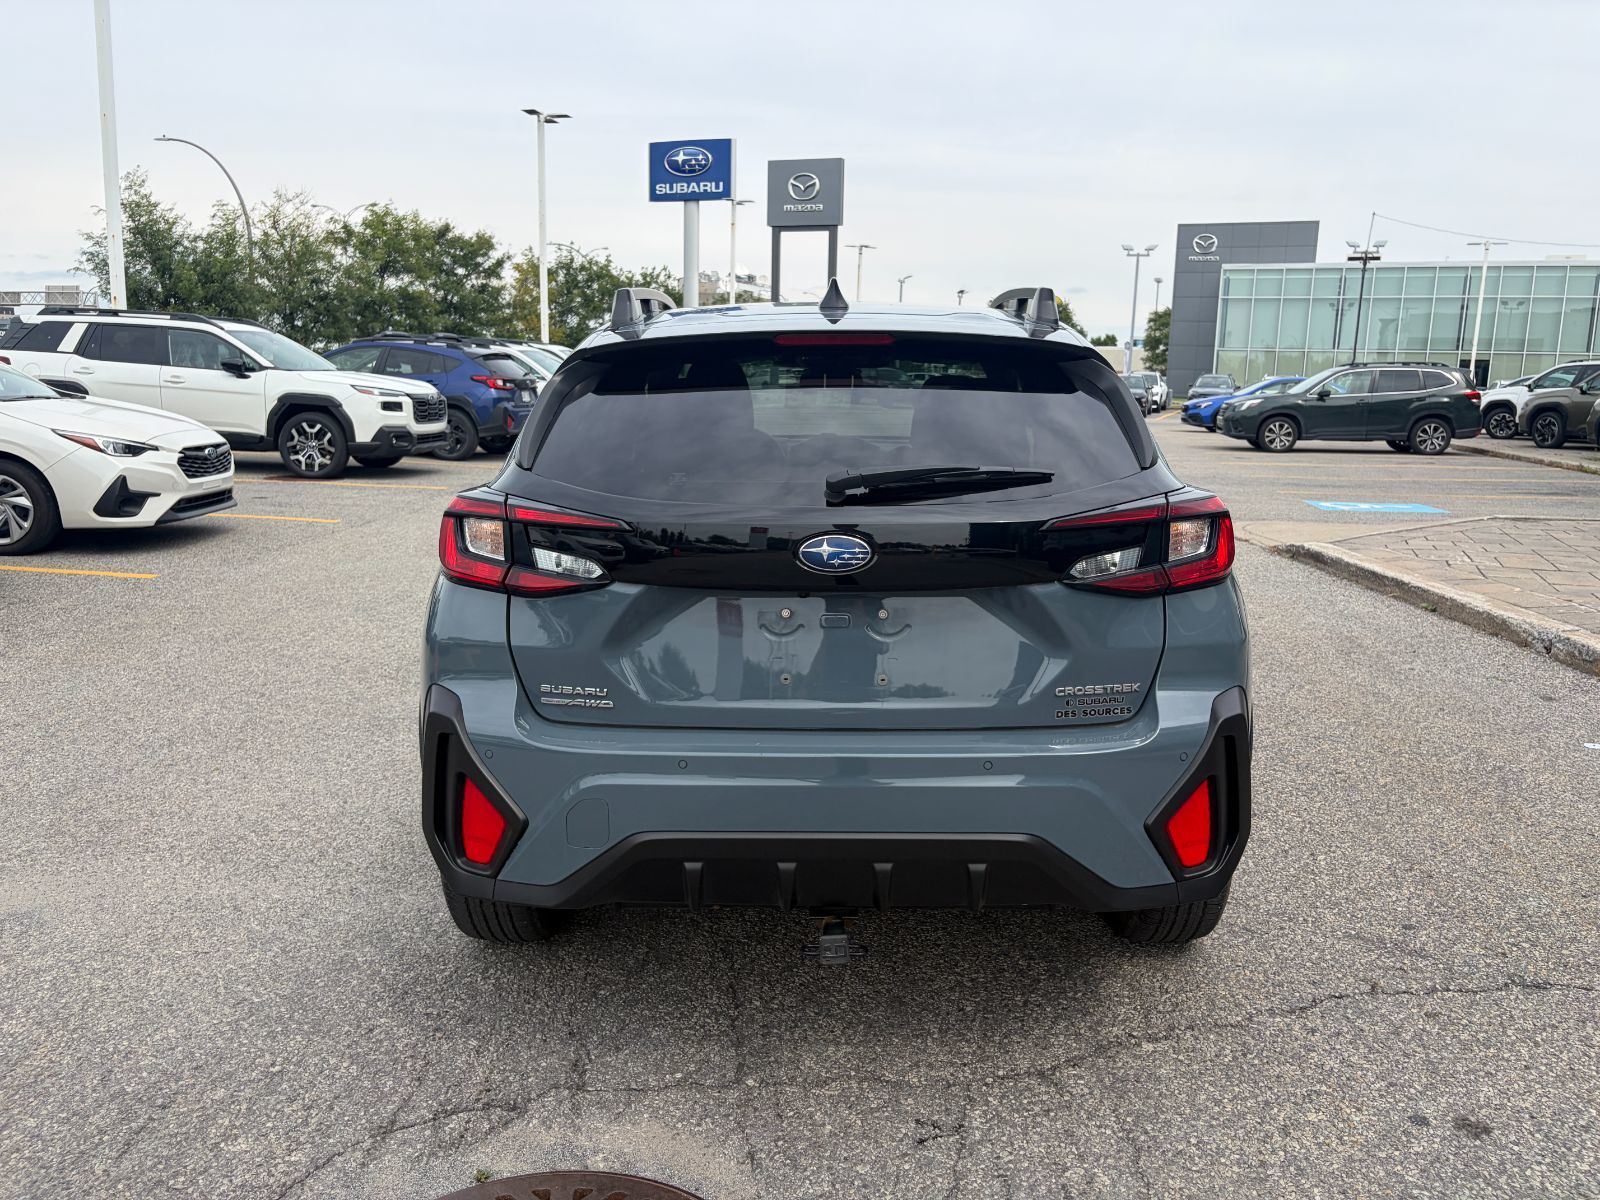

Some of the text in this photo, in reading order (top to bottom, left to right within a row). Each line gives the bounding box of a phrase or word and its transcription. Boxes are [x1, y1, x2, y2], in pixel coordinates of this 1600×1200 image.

[655, 181, 724, 195] SUBARU
[540, 684, 608, 696] SUBARU
[1055, 682, 1141, 697] CROSSTREK
[567, 698, 614, 708] AWD
[1077, 696, 1125, 706] SUBARU
[1055, 706, 1133, 719] DES SOURCES
